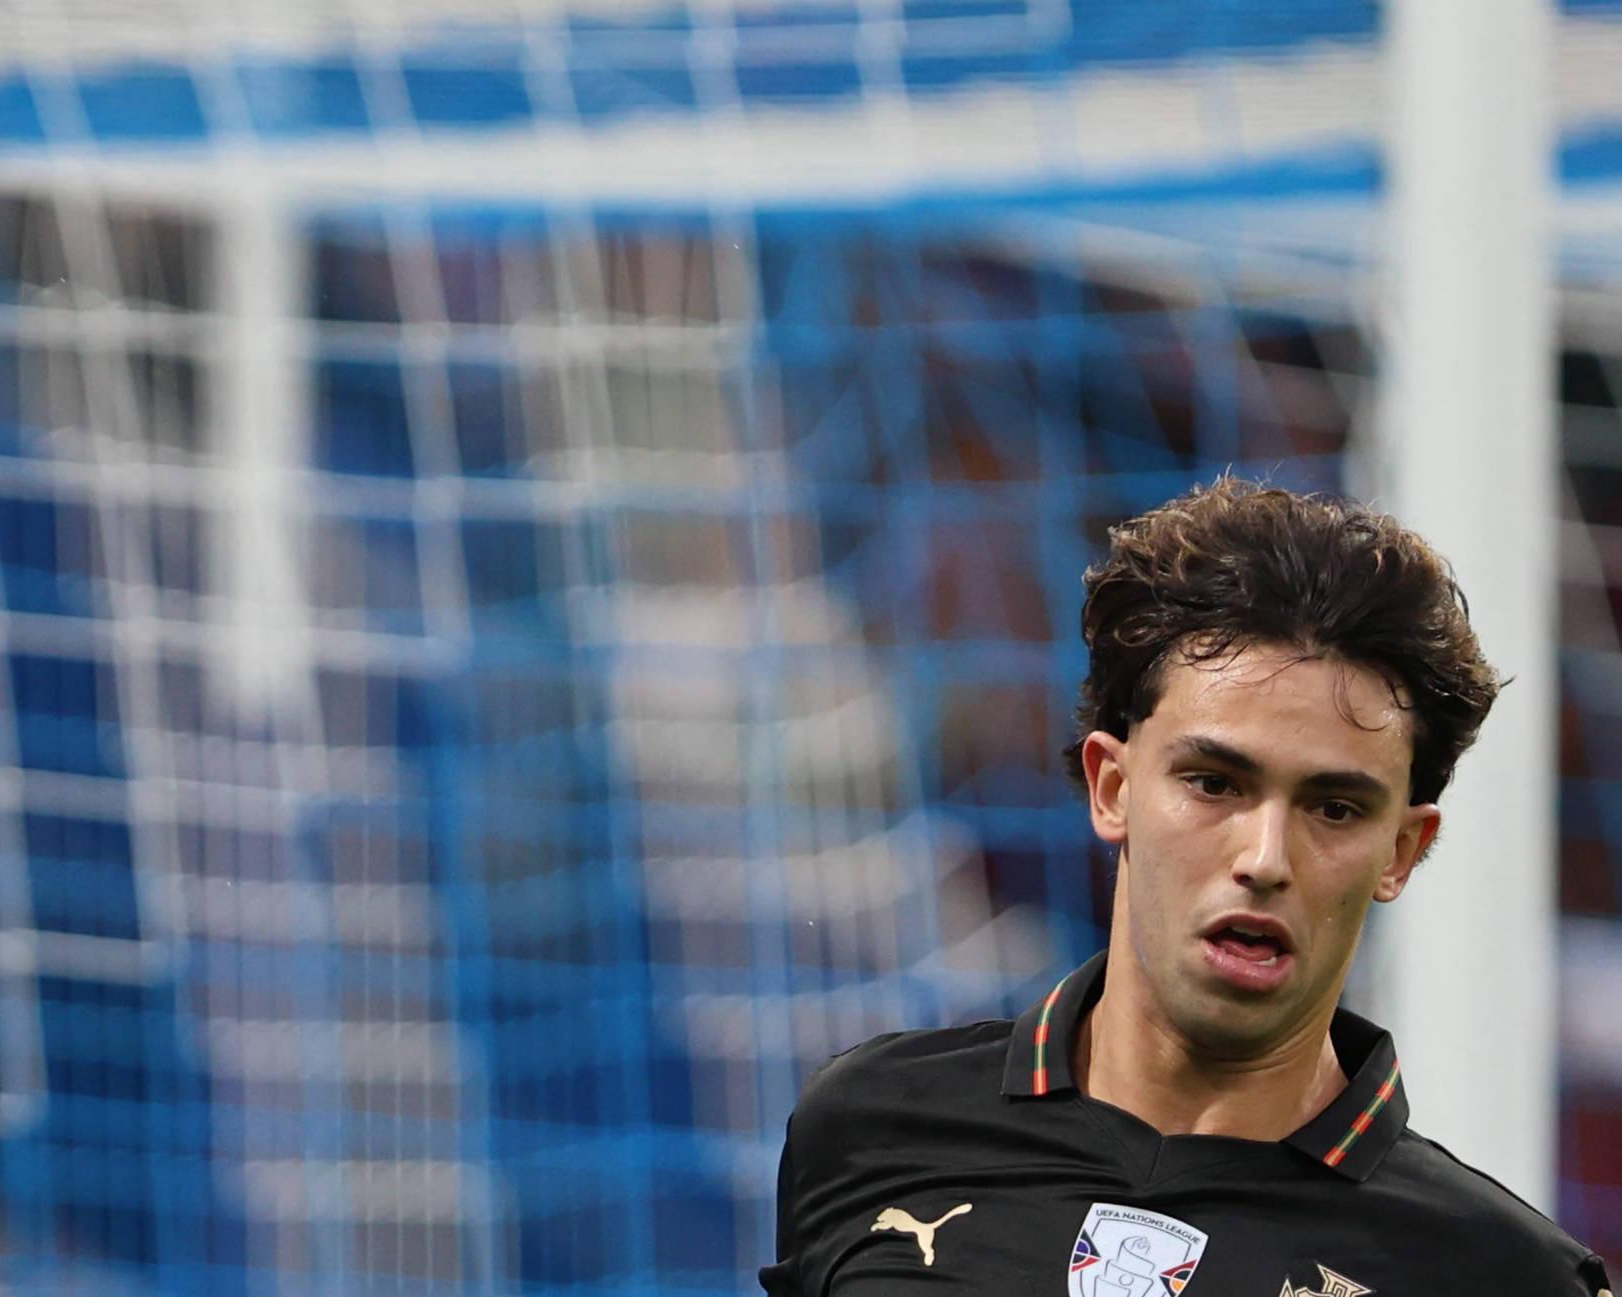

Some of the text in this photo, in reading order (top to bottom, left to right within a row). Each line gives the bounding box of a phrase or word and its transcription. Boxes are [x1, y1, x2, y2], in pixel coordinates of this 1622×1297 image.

[1096, 1209, 1201, 1245] UEFA NATIONS LEAGUE
